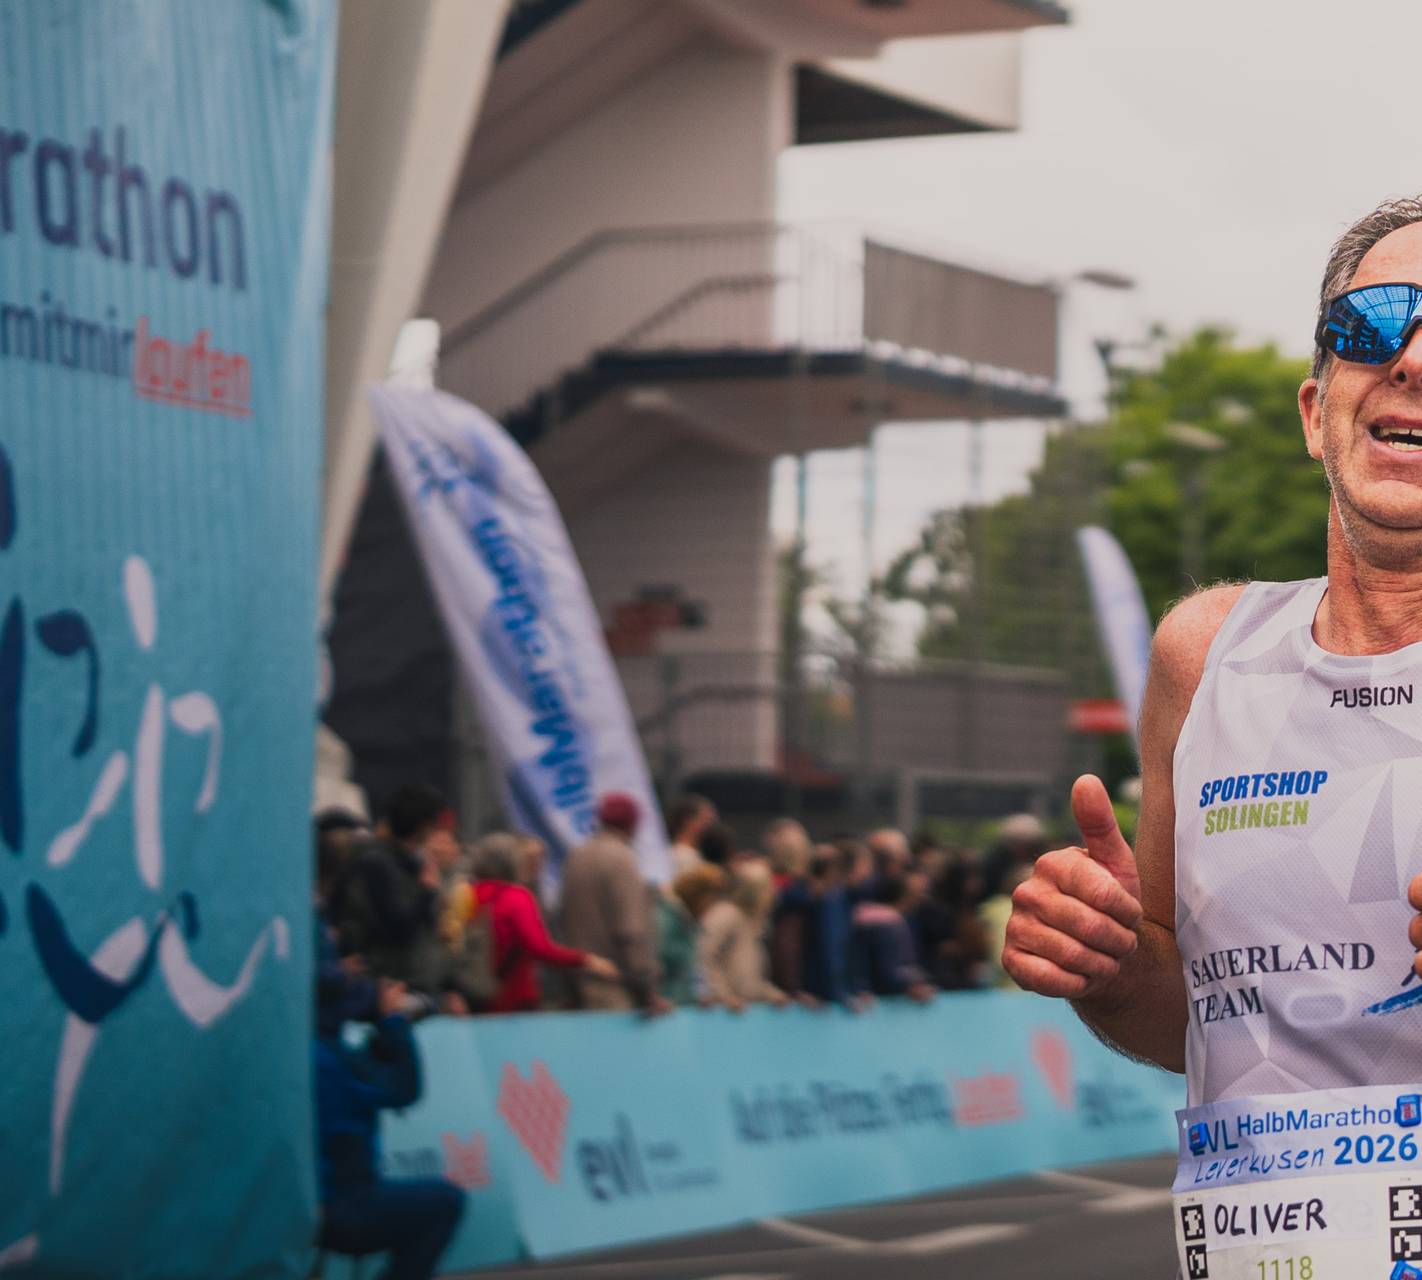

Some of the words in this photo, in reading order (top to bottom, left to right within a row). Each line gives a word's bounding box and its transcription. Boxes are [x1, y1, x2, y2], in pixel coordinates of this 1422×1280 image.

[1330, 684, 1414, 709] FUSION
[1199, 770, 1328, 808] SPORTSHOP
[1204, 800, 1310, 836] SOLINGEN
[1191, 942, 1375, 989] SAUERLAND
[1192, 986, 1264, 1026] TEAM
[1191, 1118, 1239, 1156] VL
[1237, 1104, 1397, 1138] HalbMaratho
[1194, 1147, 1325, 1184] Leverkusen
[1334, 1133, 1418, 1166] 2026
[1214, 1198, 1328, 1237] OLIVER
[1256, 1255, 1314, 1280] 1118
